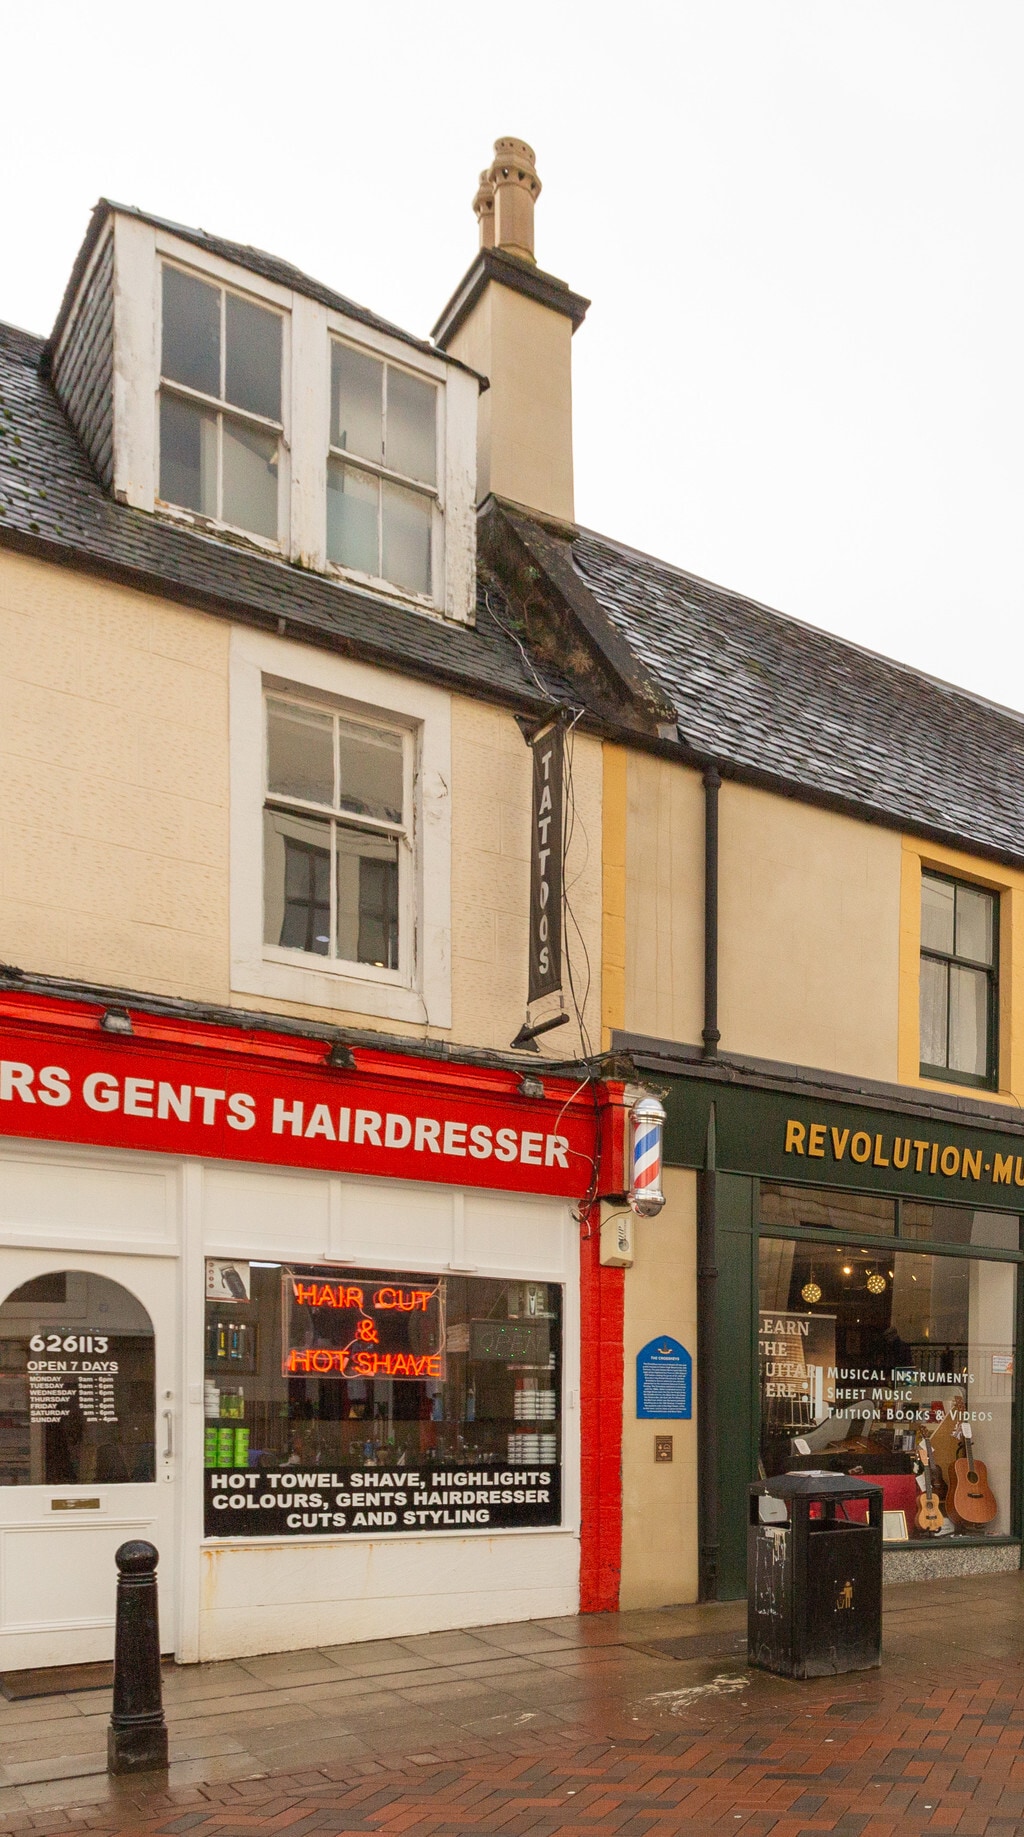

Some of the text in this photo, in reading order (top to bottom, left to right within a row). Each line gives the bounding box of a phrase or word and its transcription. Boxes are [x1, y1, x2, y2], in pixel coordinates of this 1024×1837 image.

[538, 750, 553, 975] TATTOOS
[82, 1072, 256, 1131] GENTS
[272, 1098, 570, 1168] HAIRDRESSER
[296, 1283, 434, 1312] HAIR CUT
[359, 1319, 380, 1344] &
[29, 1334, 109, 1354] 626113
[27, 1360, 119, 1371] OPEN 7 DAYS
[290, 1349, 442, 1377] HOT SHAVE
[766, 1362, 817, 1379] UITAR
[828, 1366, 975, 1384] MUSICAL INSTRUMENTS
[766, 1382, 798, 1398] ERE
[828, 1387, 912, 1401] SHEET MUSIC
[828, 1407, 993, 1422] TUITION BOOKS & VIDEOS
[211, 1472, 551, 1489] HOT TOWEL SHAVE, HIGHLIGHTS
[212, 1490, 550, 1510] COLOURS, GENTS HAIRDRESSER
[286, 1509, 490, 1528] CUTS AND STYLING
